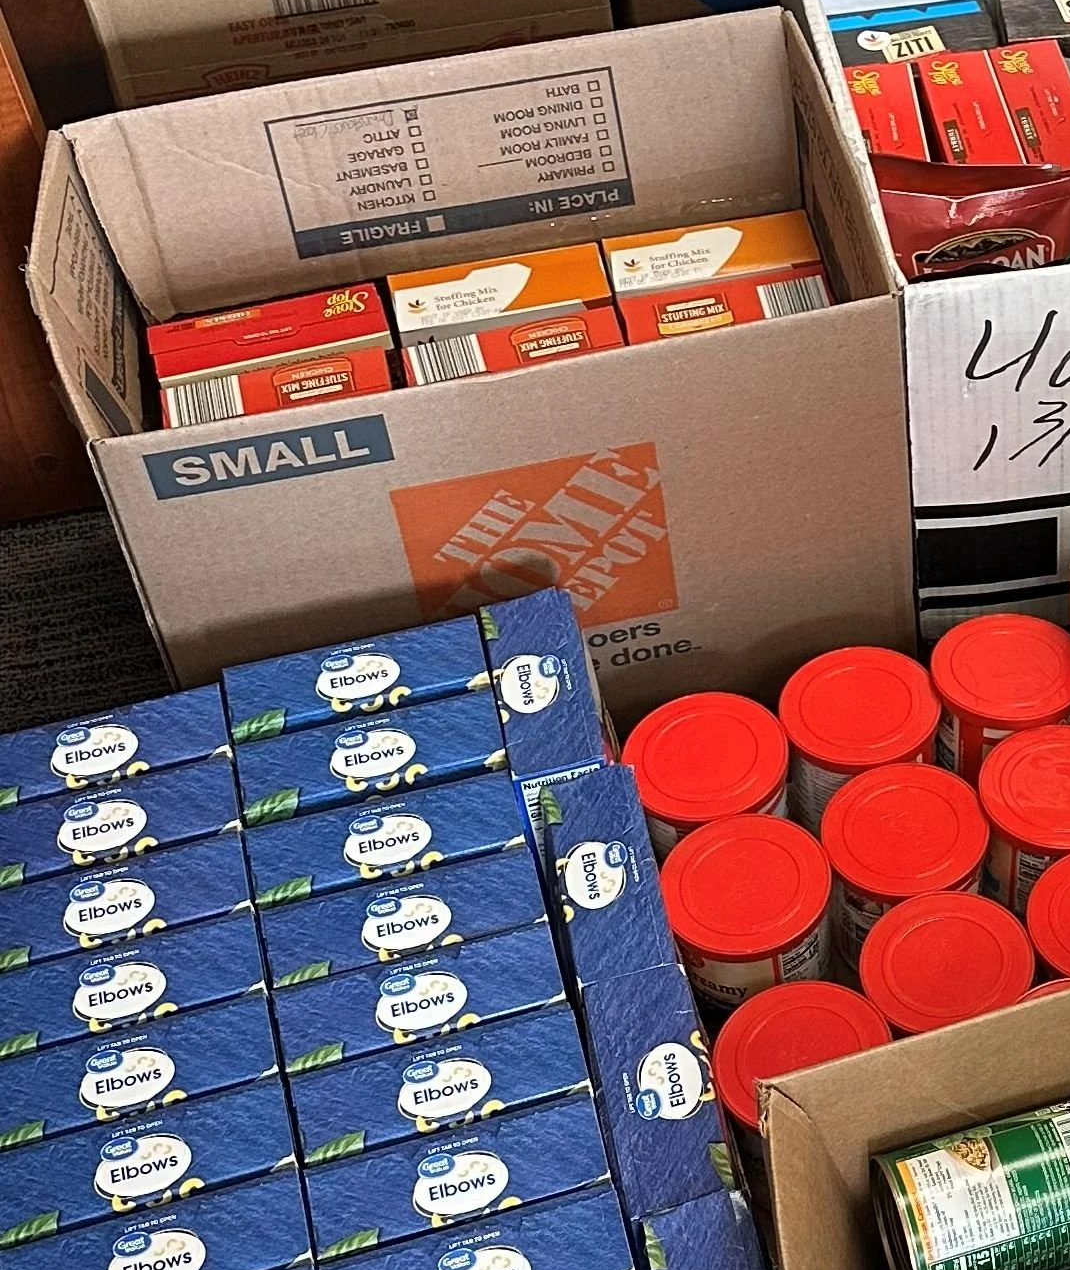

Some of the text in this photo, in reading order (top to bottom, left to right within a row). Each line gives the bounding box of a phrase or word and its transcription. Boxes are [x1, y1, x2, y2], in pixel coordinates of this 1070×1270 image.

[891, 38, 935, 59] ZITI
[545, 82, 580, 98] BATH
[493, 99, 583, 124] DINING ROOM
[362, 128, 401, 144] ATTIC
[499, 116, 587, 139] LIVING ROOM
[347, 144, 404, 163] GARAGE
[499, 132, 589, 156] FAMILY ROOM
[525, 148, 593, 168] BEDROOM
[335, 161, 408, 182] BASEMENT
[537, 164, 595, 183] PRIMARY
[349, 177, 413, 196] LAUNDRY
[357, 193, 416, 211] KITCHEN
[527, 188, 620, 214] PLACE IN:
[339, 220, 422, 245] FRAGILE
[647, 248, 711, 265] Stuffing Mix
[650, 256, 709, 271] for Chicken
[432, 285, 499, 304] Stuffing Mix
[435, 296, 496, 312] for Chicken
[661, 302, 725, 323] STUFFING MIX
[519, 331, 585, 353] STUFFING MIX
[280, 373, 349, 395] STUFFING MIX
[172, 430, 371, 487] SMALL
[412, 1075, 480, 1106] Elbows
[110, 1153, 179, 1184] Elbows
[428, 1170, 496, 1202] Elbows
